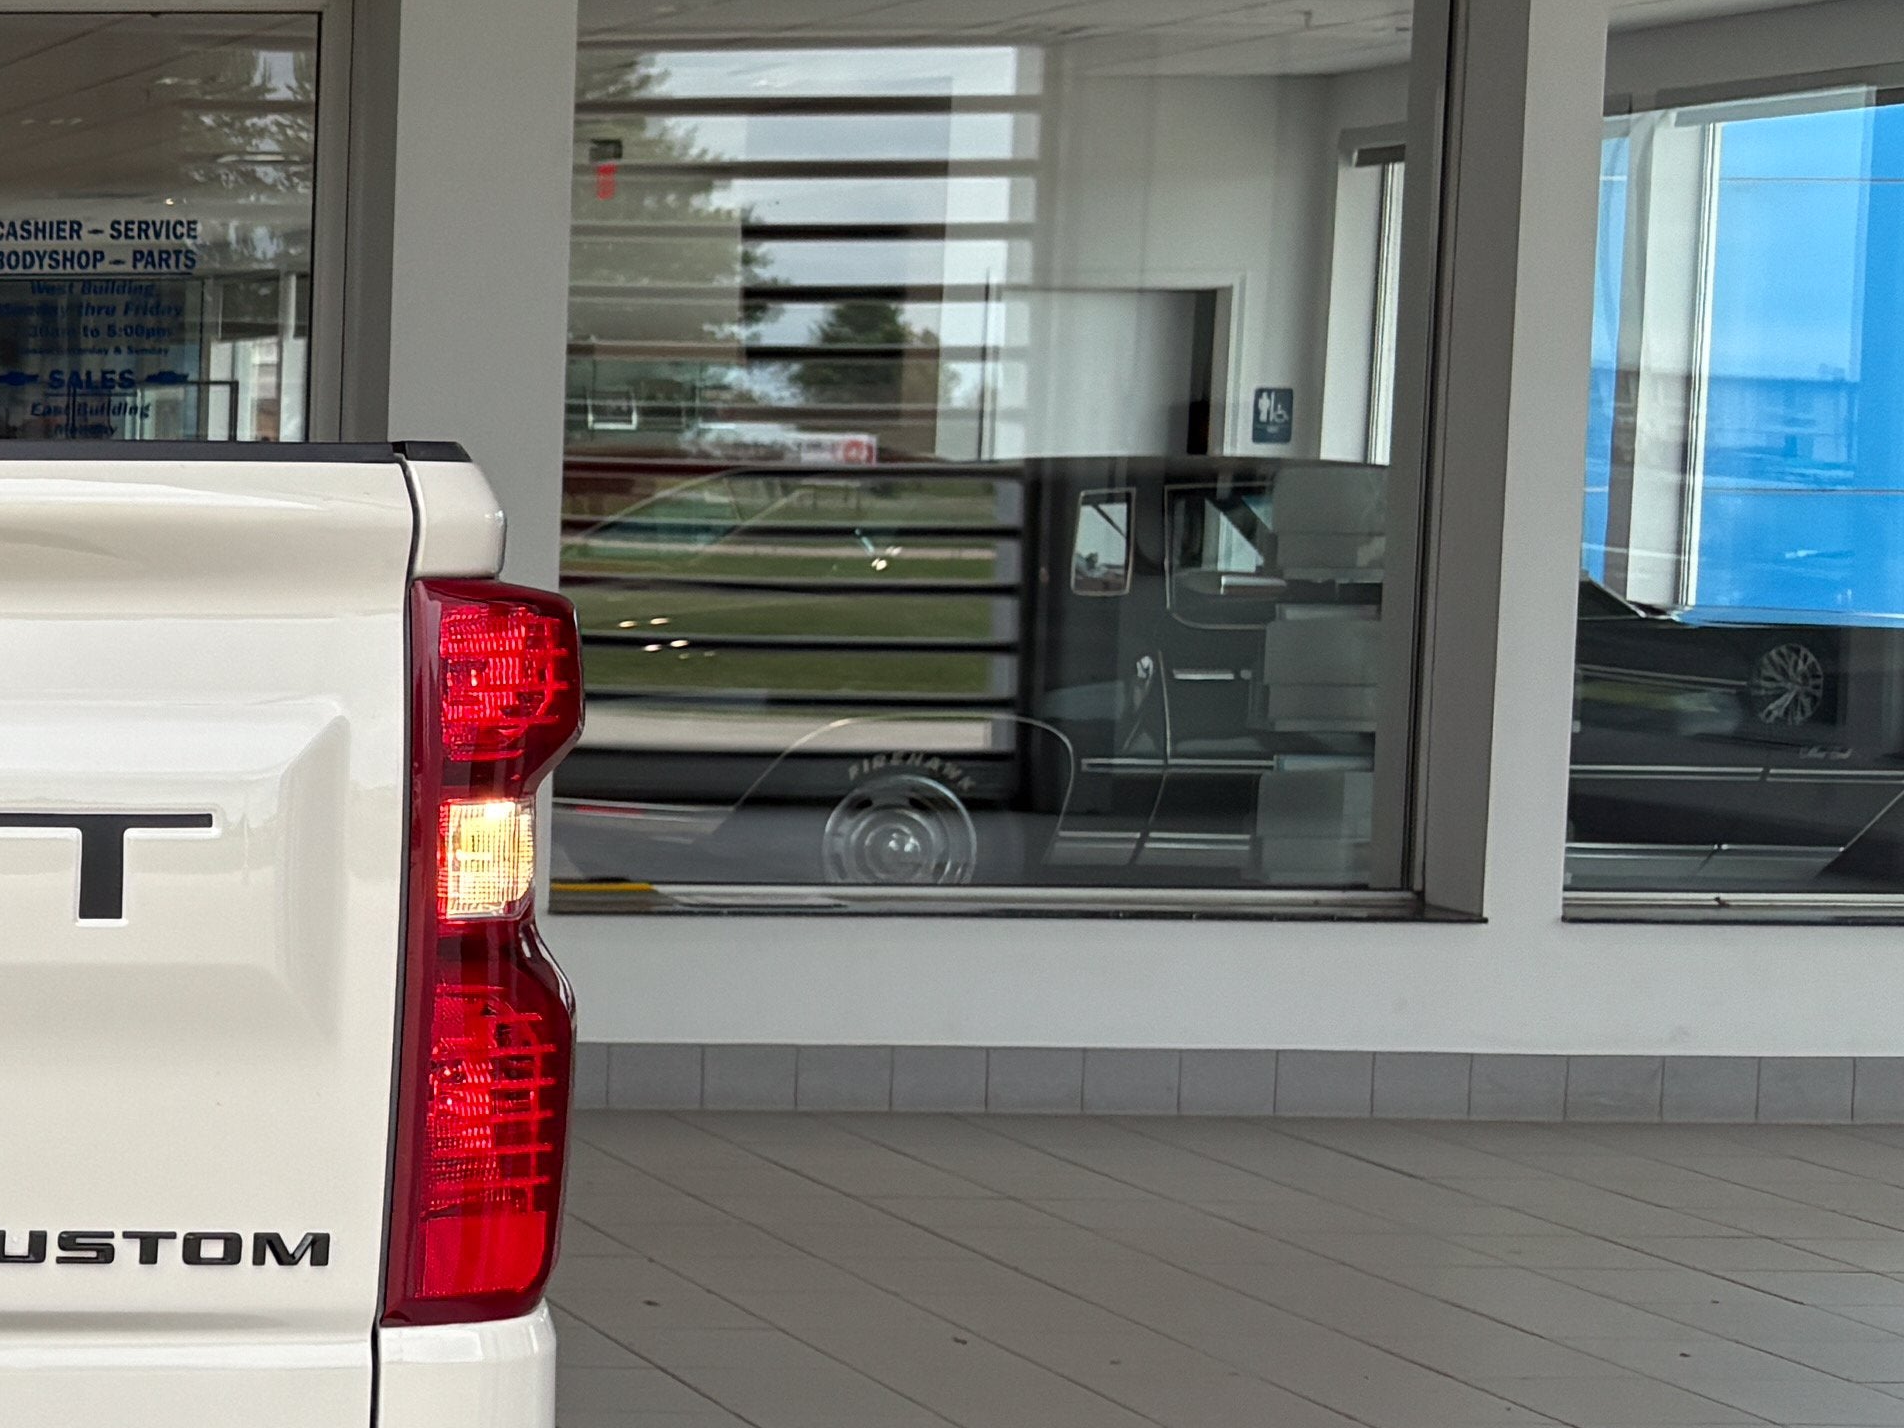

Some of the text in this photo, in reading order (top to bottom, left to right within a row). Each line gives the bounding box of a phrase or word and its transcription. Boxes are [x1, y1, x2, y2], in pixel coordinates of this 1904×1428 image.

[109, 220, 198, 241] SERVICE
[132, 249, 197, 270] PARTS
[30, 280, 156, 298] West Building
[123, 301, 183, 319] Friday
[83, 325, 100, 339] to
[47, 369, 136, 390] SALES
[848, 750, 976, 791] FIREHAWK
